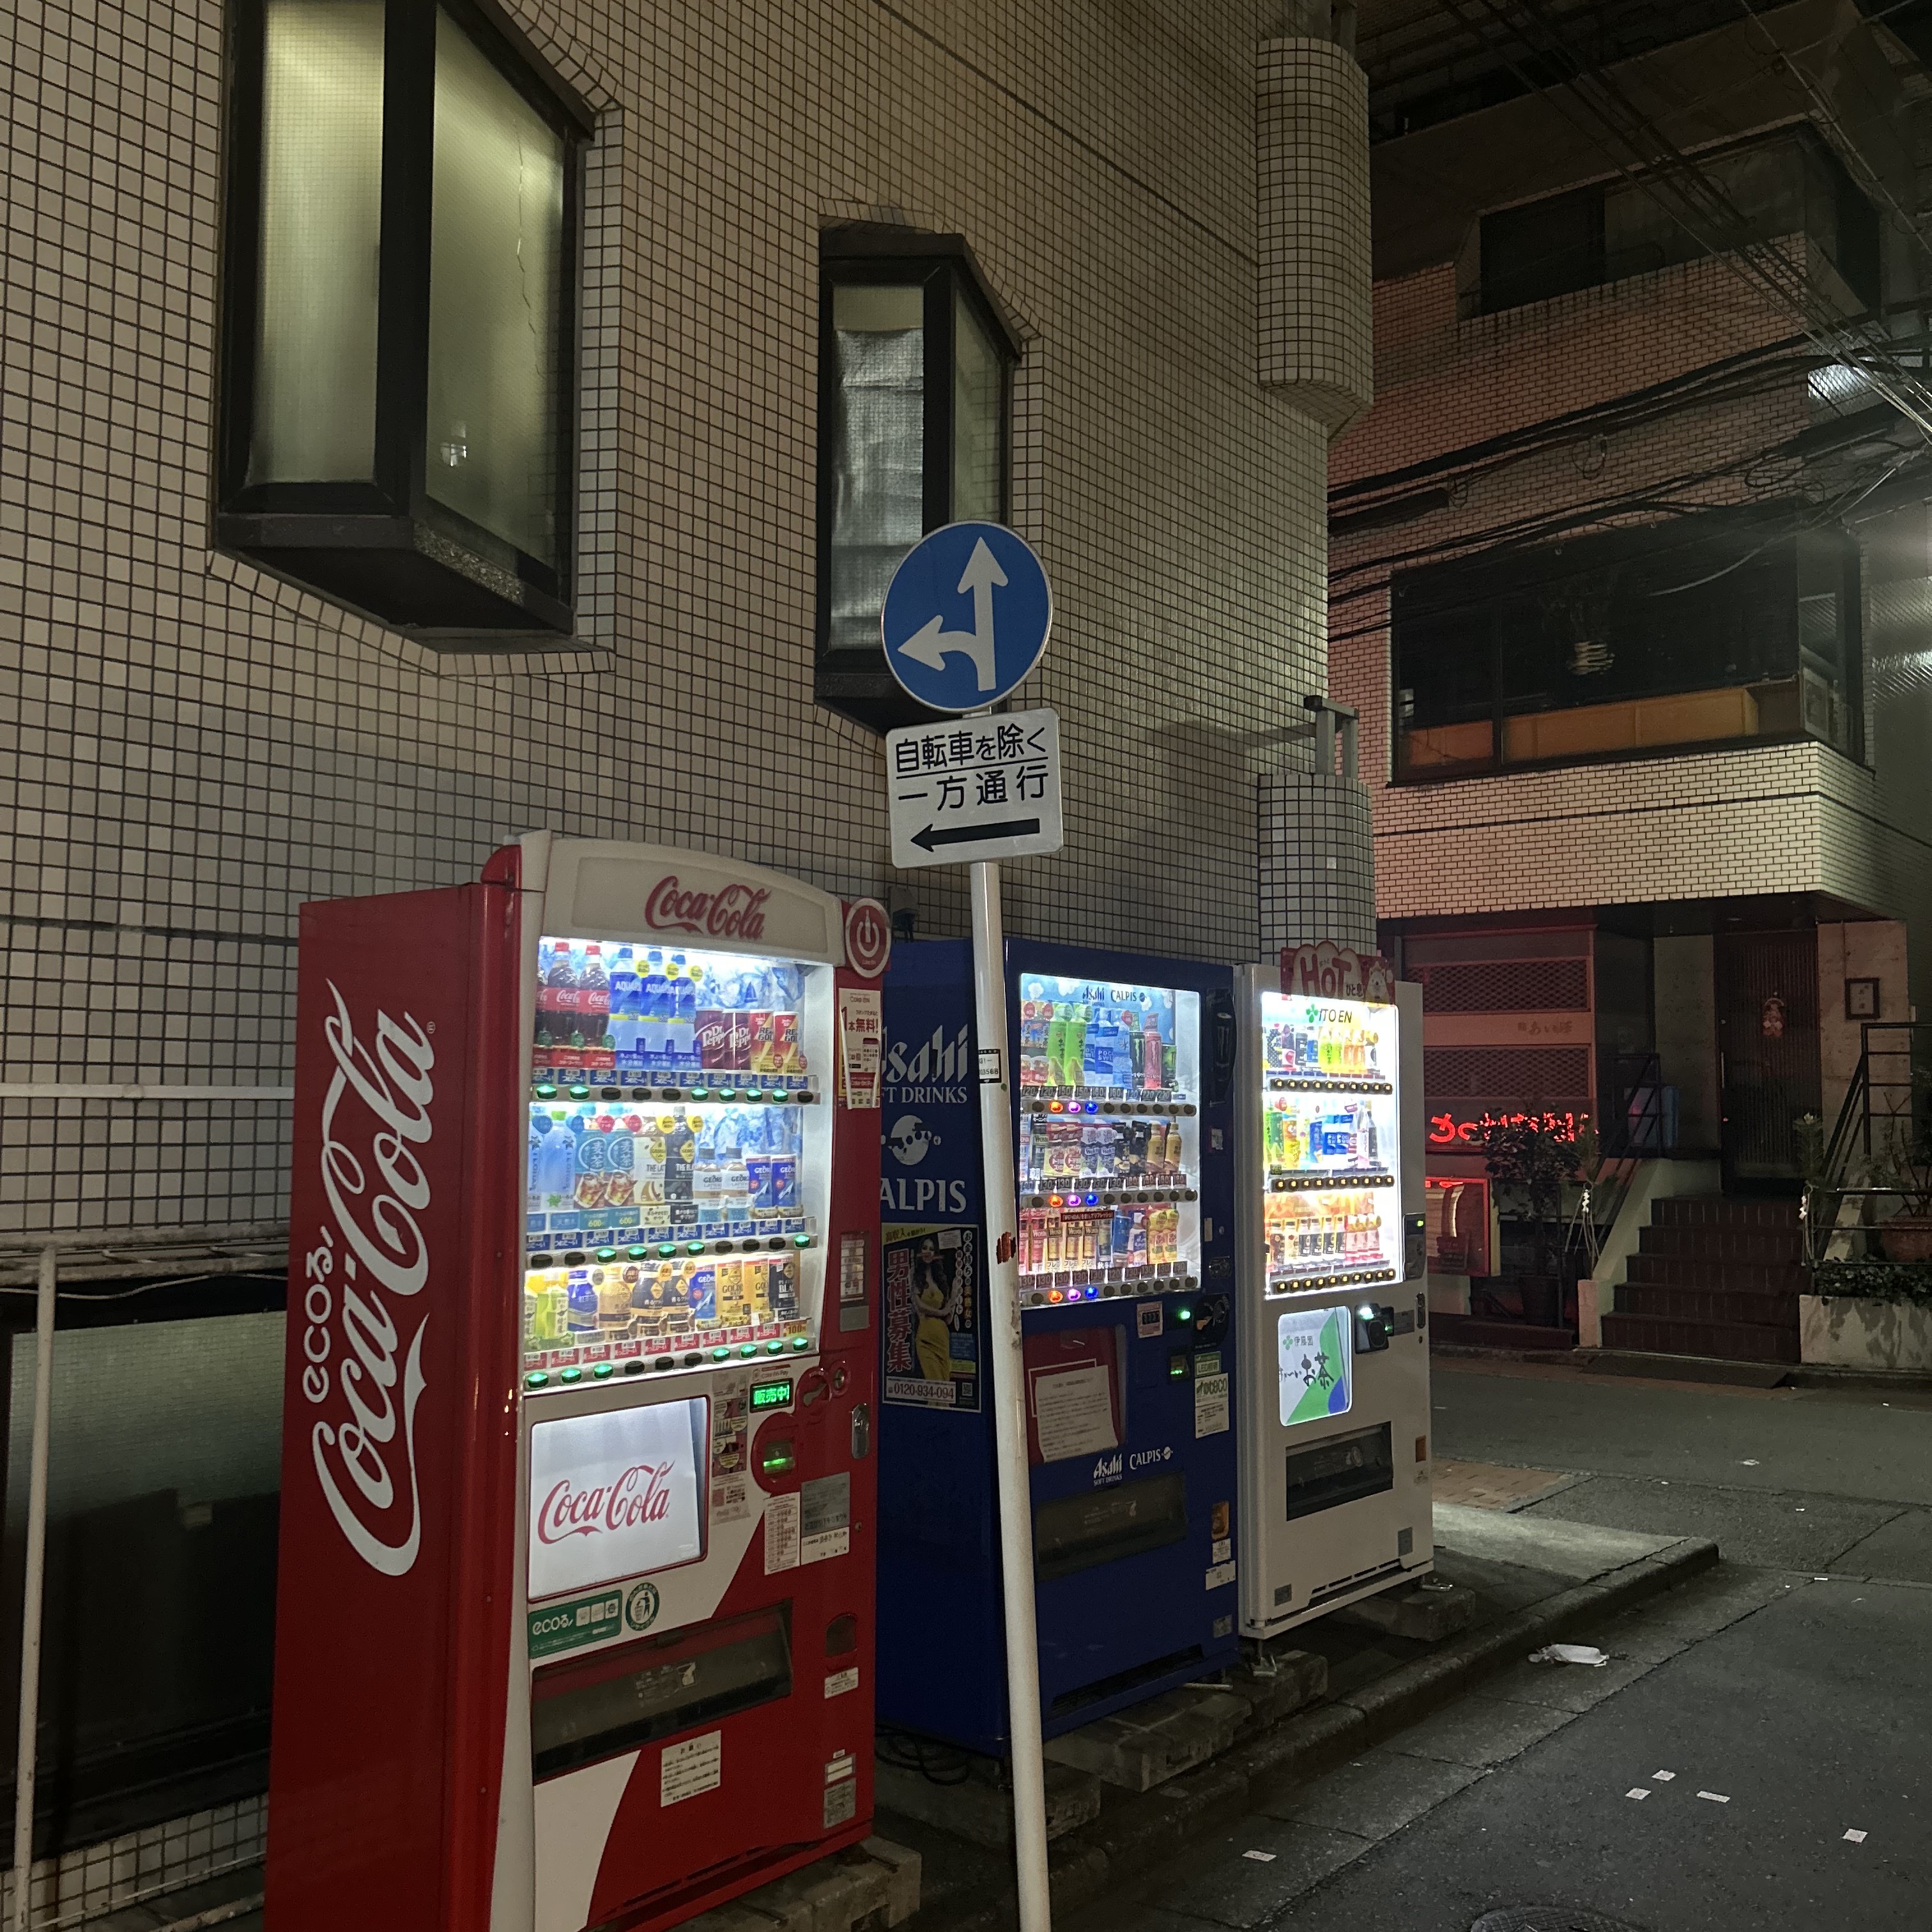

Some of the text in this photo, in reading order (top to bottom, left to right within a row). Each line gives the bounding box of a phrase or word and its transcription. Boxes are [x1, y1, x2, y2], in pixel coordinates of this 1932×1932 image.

[896, 723, 1046, 772] 自転車を除く
[898, 764, 1048, 811] 一方通行
[645, 875, 771, 939] Coca-Cola
[1110, 990, 1137, 1002] CALPIS
[1300, 953, 1352, 998] HOT
[1338, 1009, 1353, 1023] EN
[881, 1023, 968, 1084] sahi
[901, 1087, 968, 1103] DRINKS
[880, 1177, 967, 1213] ALPIS
[312, 978, 434, 1576] Coca-Cola
[887, 1248, 912, 1373] 男性募集
[754, 1384, 790, 1405] 販売中!
[1093, 1453, 1123, 1479] Asahi
[1129, 1448, 1161, 1470] CALPIS
[538, 1460, 675, 1544] Coca-Cola
